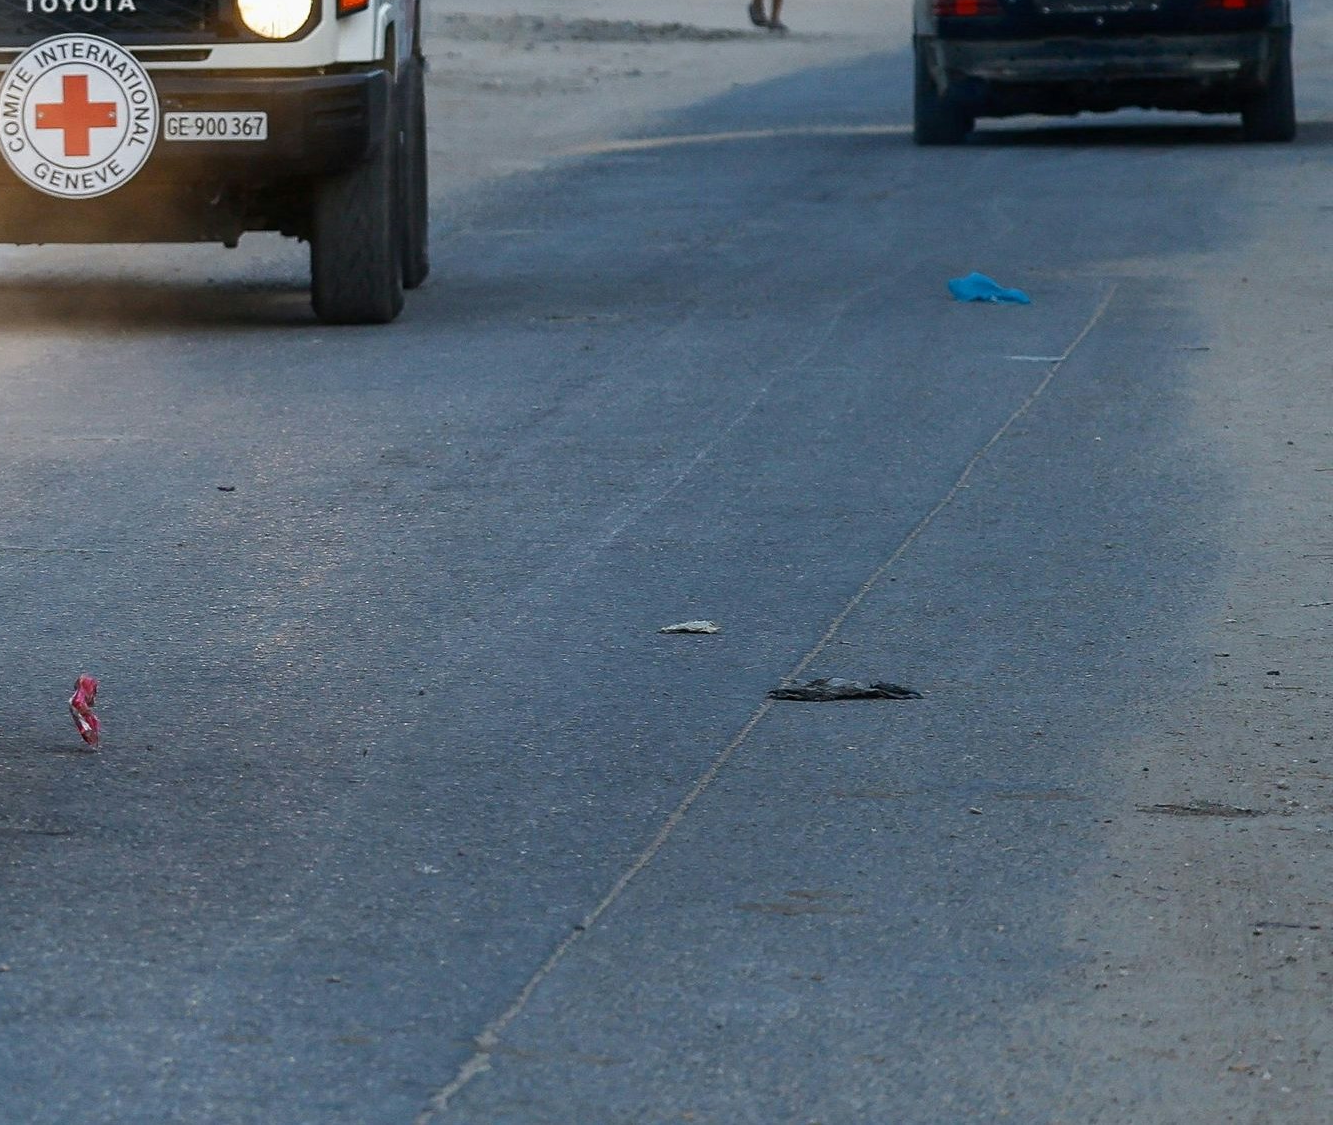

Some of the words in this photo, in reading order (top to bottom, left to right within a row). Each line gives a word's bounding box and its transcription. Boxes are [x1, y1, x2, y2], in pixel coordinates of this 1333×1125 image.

[3, 67, 33, 153] COMITE
[34, 42, 150, 147] INTERNATIONAL
[34, 159, 124, 189] GENEVE
